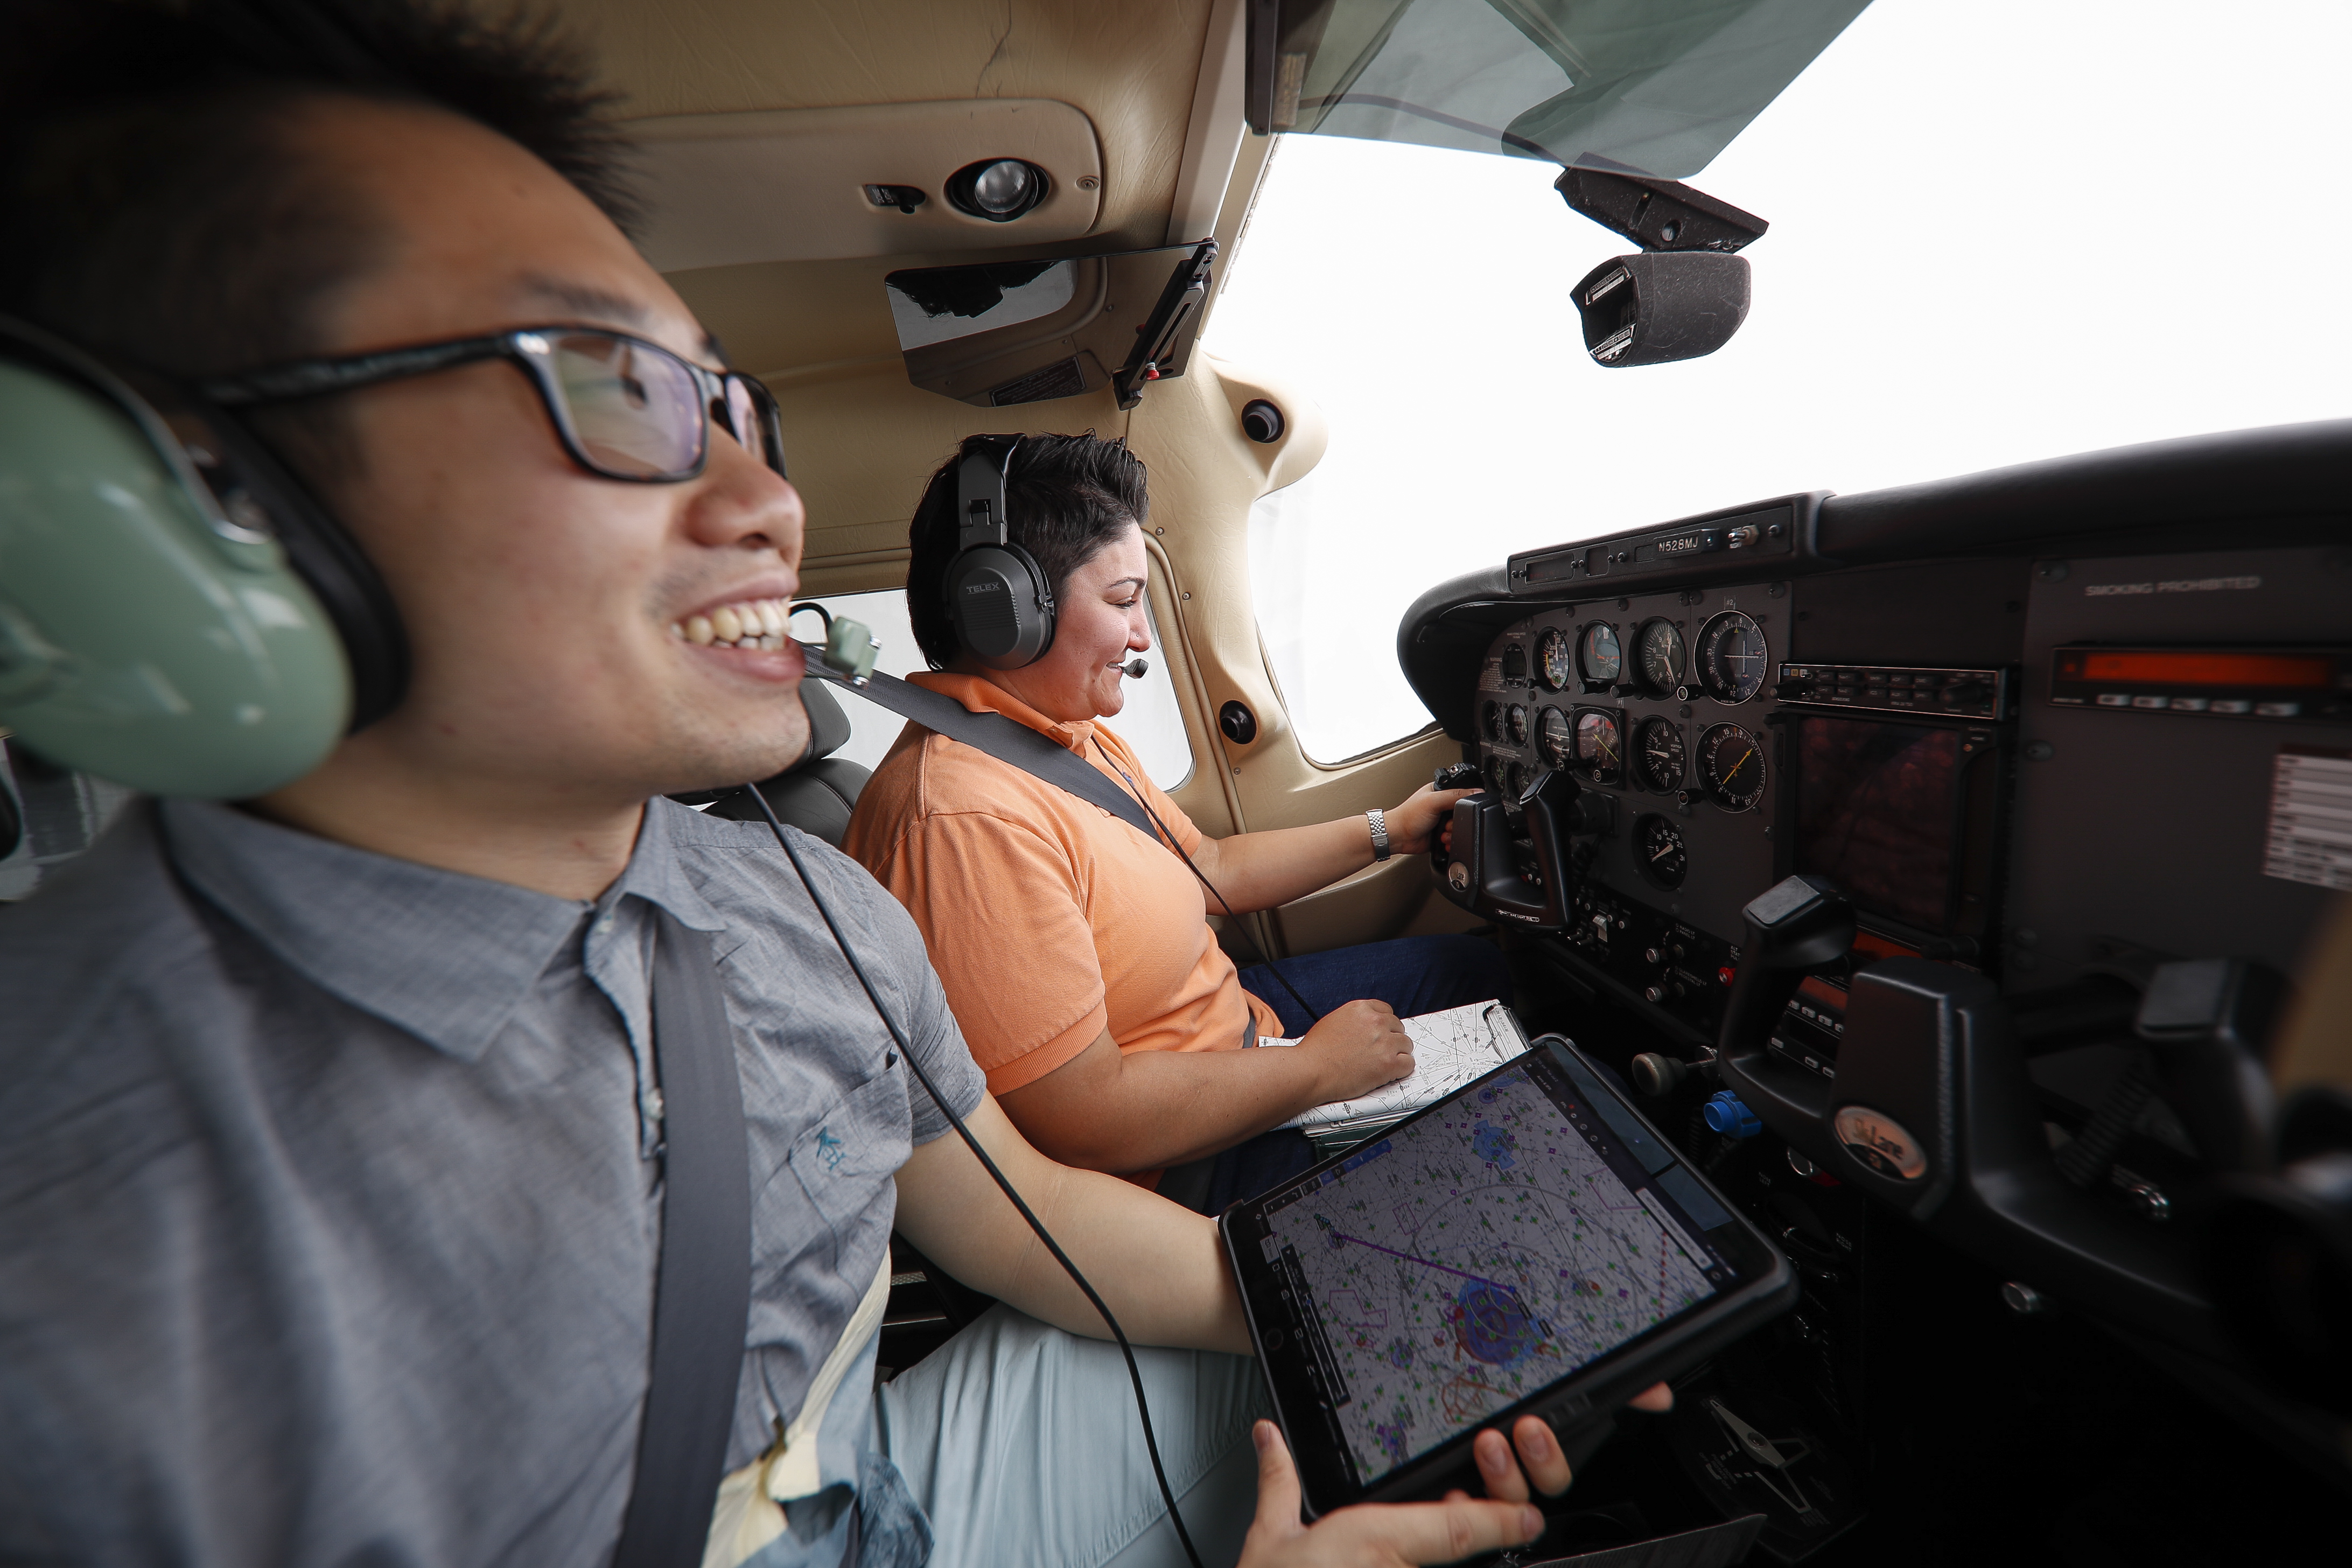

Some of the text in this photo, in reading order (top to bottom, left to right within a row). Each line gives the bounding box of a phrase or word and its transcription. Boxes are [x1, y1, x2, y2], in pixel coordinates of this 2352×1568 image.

[1658, 536, 1698, 552] N528MJ
[966, 583, 1000, 593] TELEX
[2084, 575, 2263, 596] SMOKING PROHIBITED
[1707, 648, 1713, 656] 33
[1709, 666, 1715, 674] 30
[1745, 688, 1752, 696] 21
[1679, 925, 1691, 934] RADIO
[1679, 929, 1691, 938] PANEL
[1678, 967, 1702, 984] GLARESHIELD
[1678, 971, 1697, 985] PEDESTAL
[1710, 1459, 1729, 1480] ROTATE
[1711, 1453, 1738, 1484] PUSH DOWN
